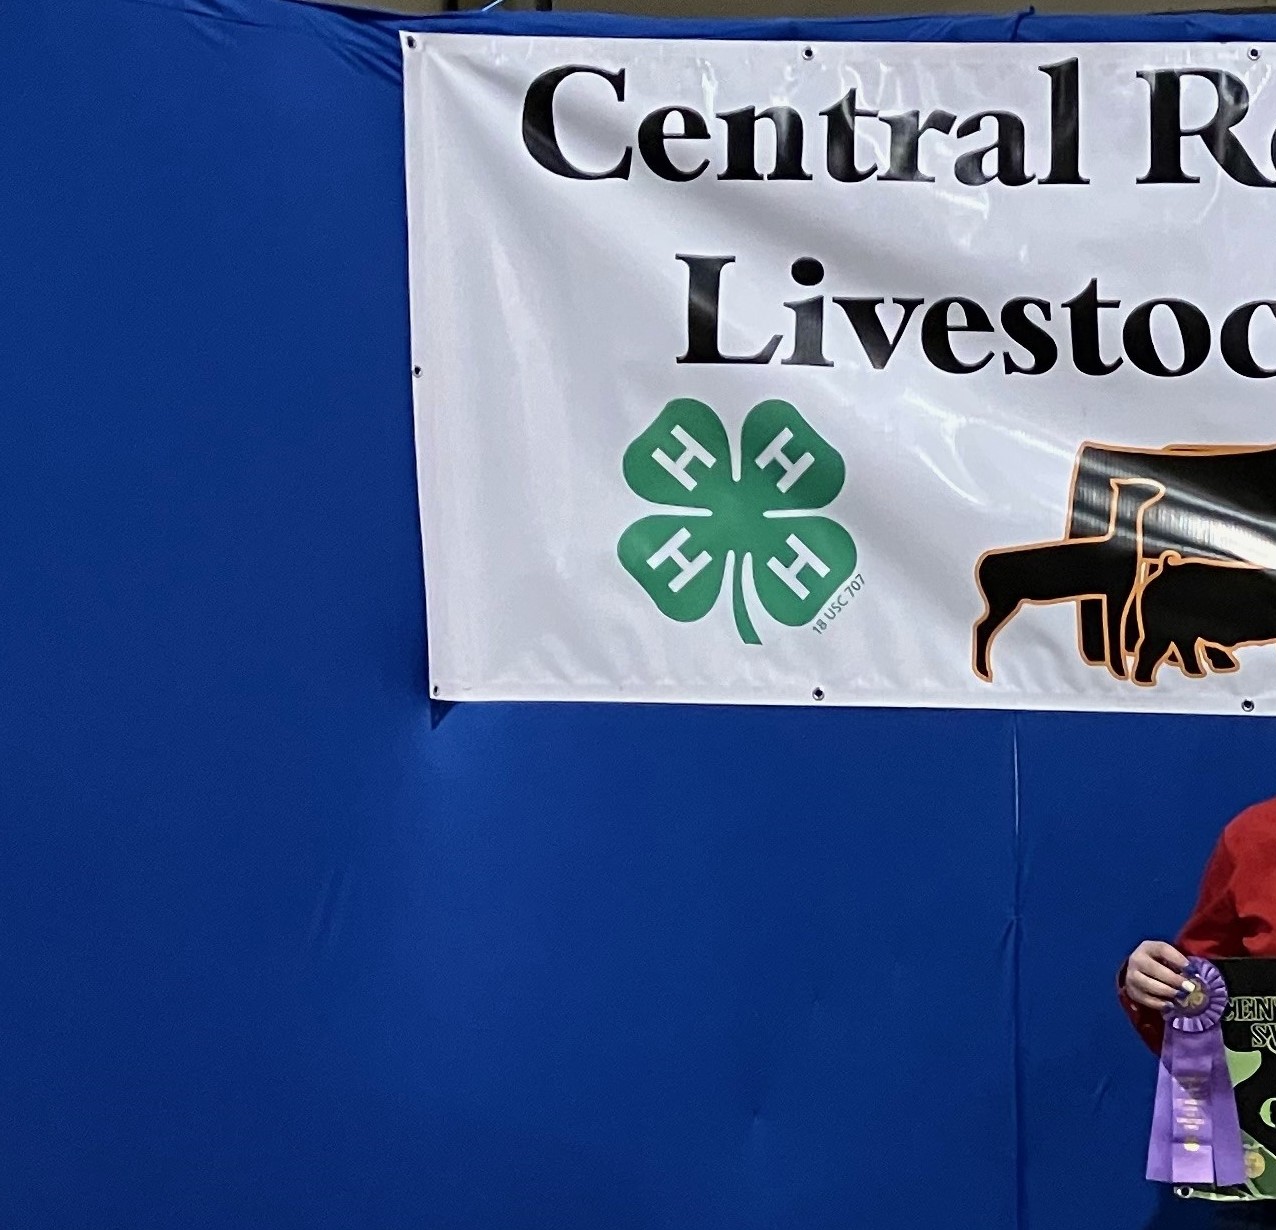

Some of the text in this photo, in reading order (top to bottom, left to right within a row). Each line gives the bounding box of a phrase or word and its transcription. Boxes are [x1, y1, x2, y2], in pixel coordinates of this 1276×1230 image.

[521, 56, 1092, 188] Central
[651, 424, 815, 494] H H
[646, 526, 831, 600] H H
[812, 573, 866, 635] 18 USC 707
